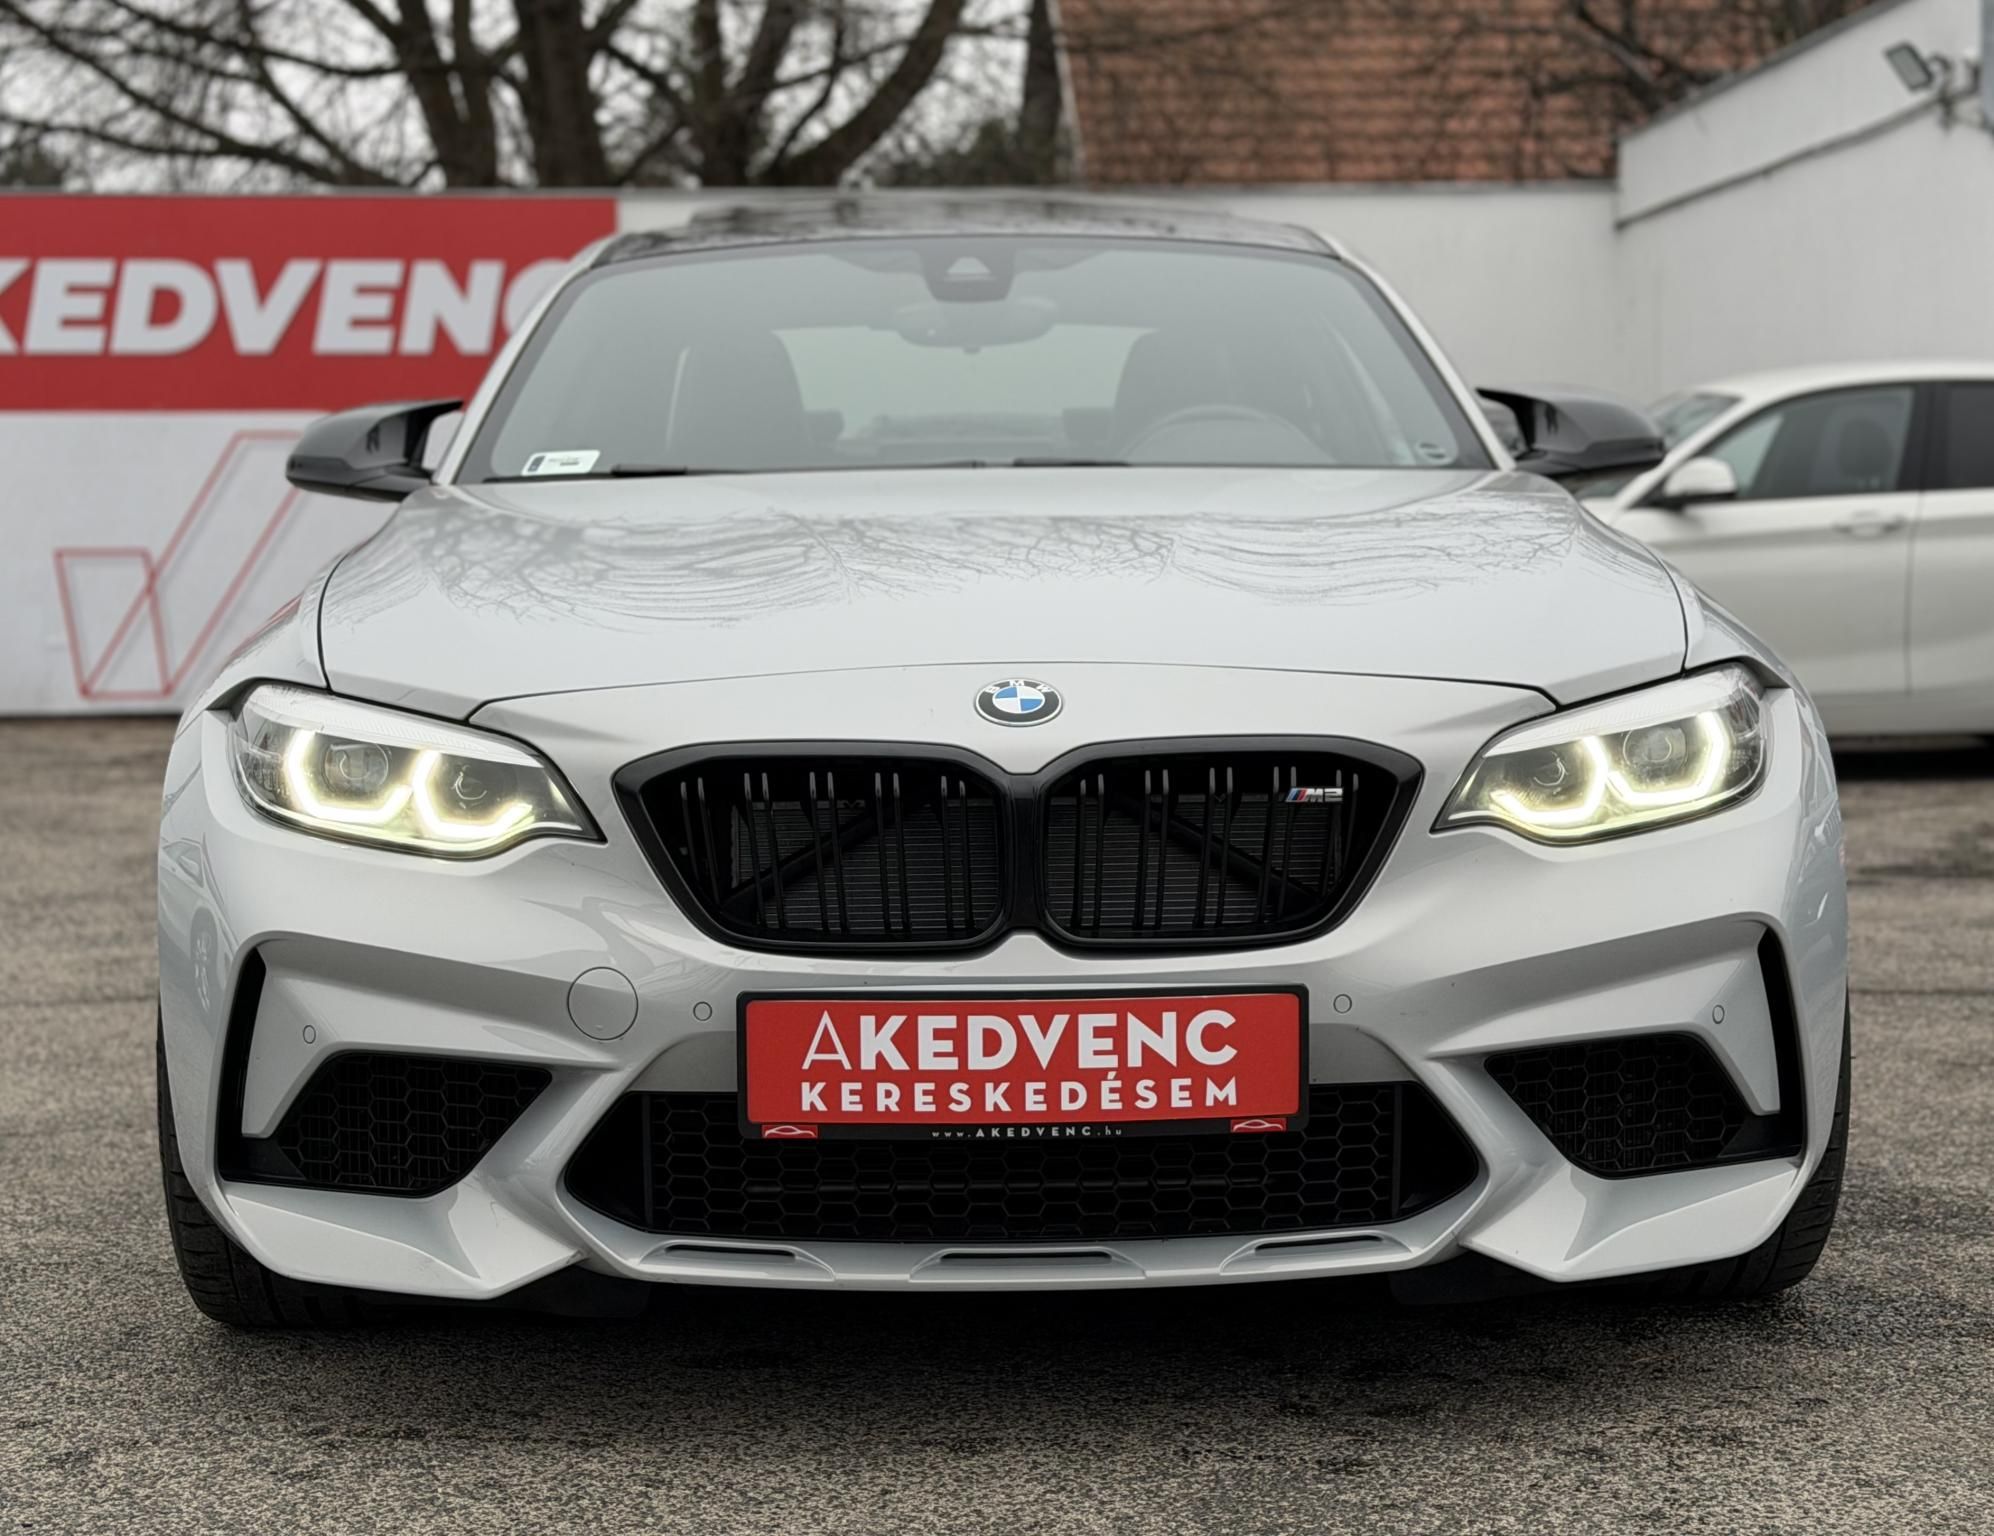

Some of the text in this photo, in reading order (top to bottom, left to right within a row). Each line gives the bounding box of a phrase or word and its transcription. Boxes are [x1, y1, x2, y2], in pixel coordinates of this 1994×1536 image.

[0, 257, 567, 355] EDVEN
[983, 679, 1055, 694] BMW
[801, 1071, 1238, 1113] KERESKEDÉSEM
[931, 1125, 1123, 1139] www.AKEDVENC.hu
